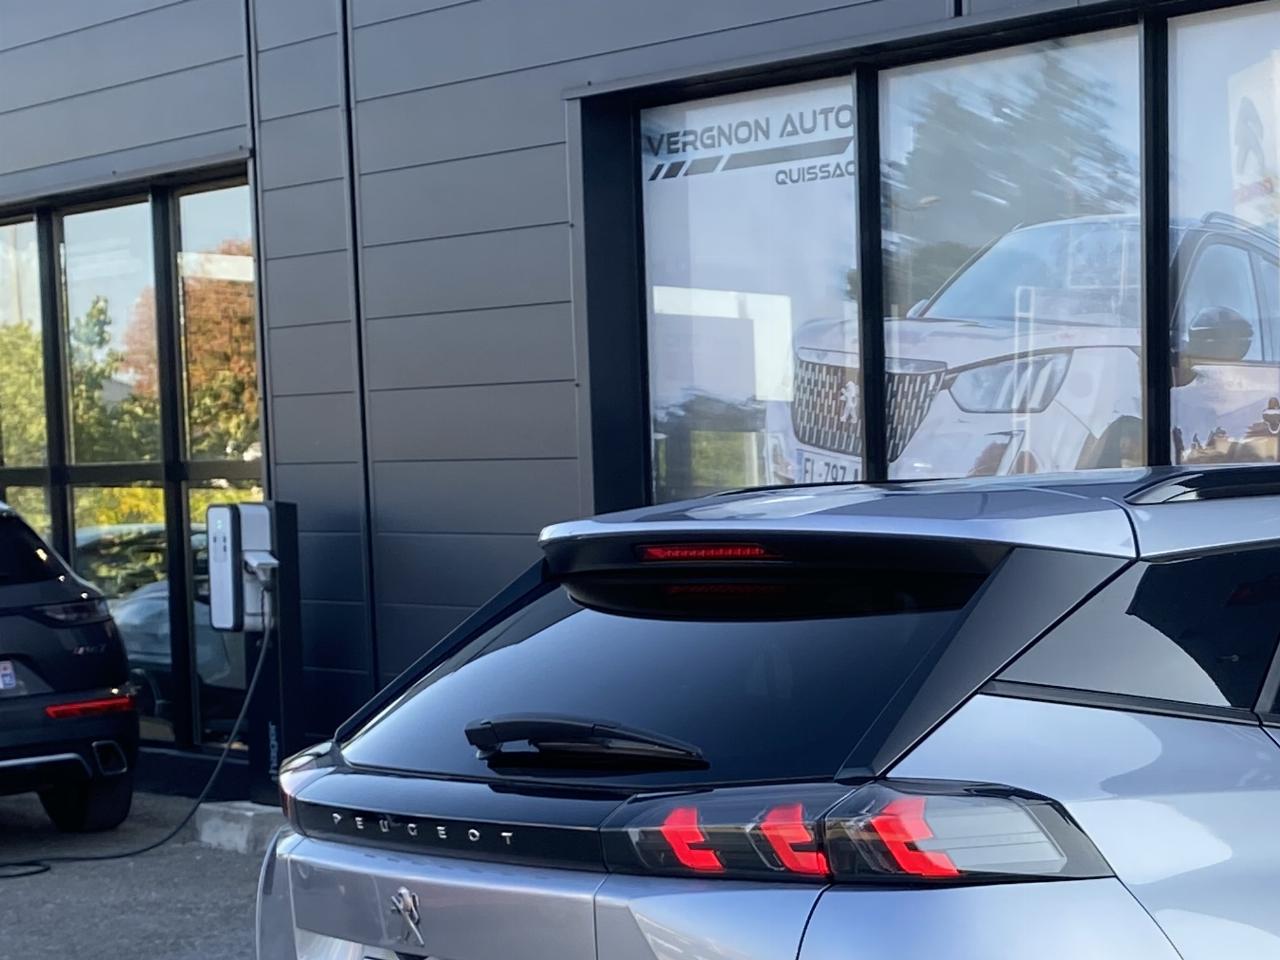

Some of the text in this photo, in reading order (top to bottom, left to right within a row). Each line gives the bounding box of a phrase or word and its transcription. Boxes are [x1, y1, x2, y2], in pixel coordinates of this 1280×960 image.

[645, 104, 855, 157] VERGNON AUTO
[331, 812, 514, 845] PEUGEOT
